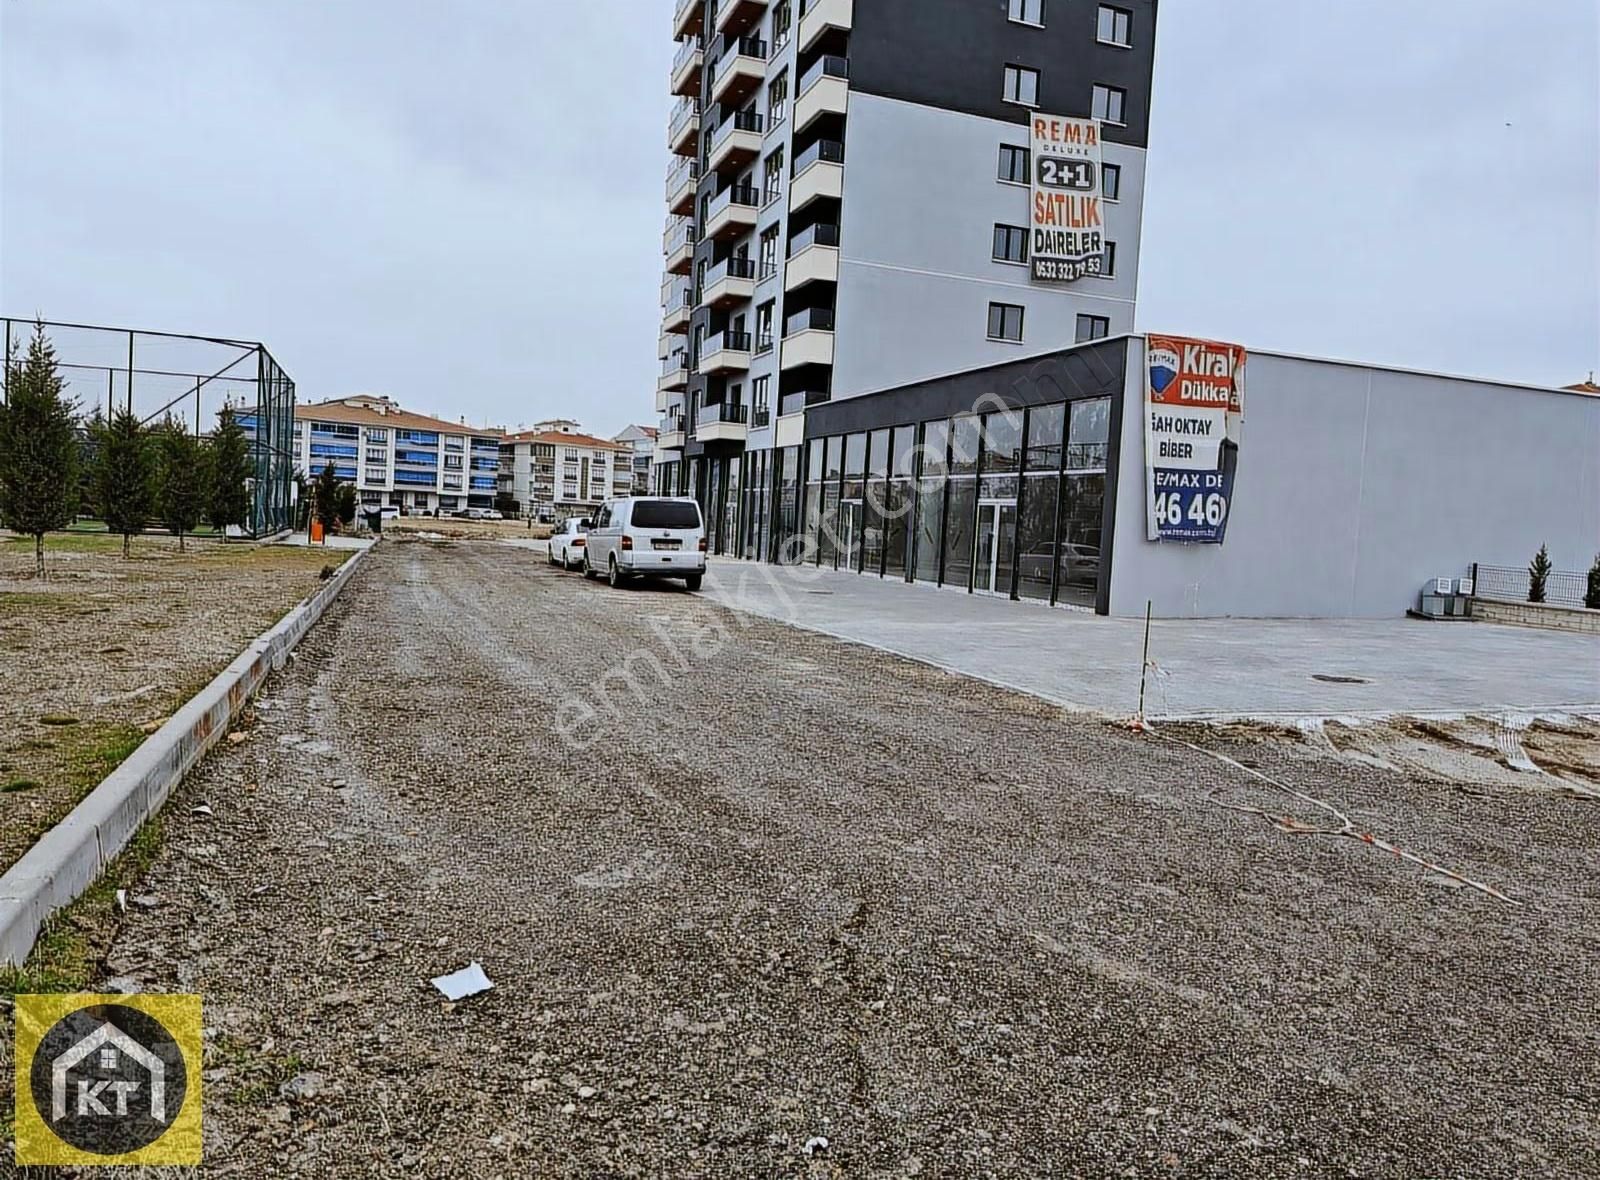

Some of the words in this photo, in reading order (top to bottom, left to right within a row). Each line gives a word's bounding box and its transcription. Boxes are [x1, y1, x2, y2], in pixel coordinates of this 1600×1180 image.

[1035, 119, 1096, 146] REMA
[1042, 160, 1090, 187] 2+1
[1035, 191, 1101, 228] SATILIK
[1035, 228, 1100, 256] DAİRELER
[1036, 260, 1056, 278] 0532
[1058, 262, 1073, 280] 322
[1088, 258, 1100, 273] 53
[1175, 418, 1212, 436] OKTAY
[1160, 438, 1192, 459] BİBER
[1156, 472, 1200, 488] E/MAX
